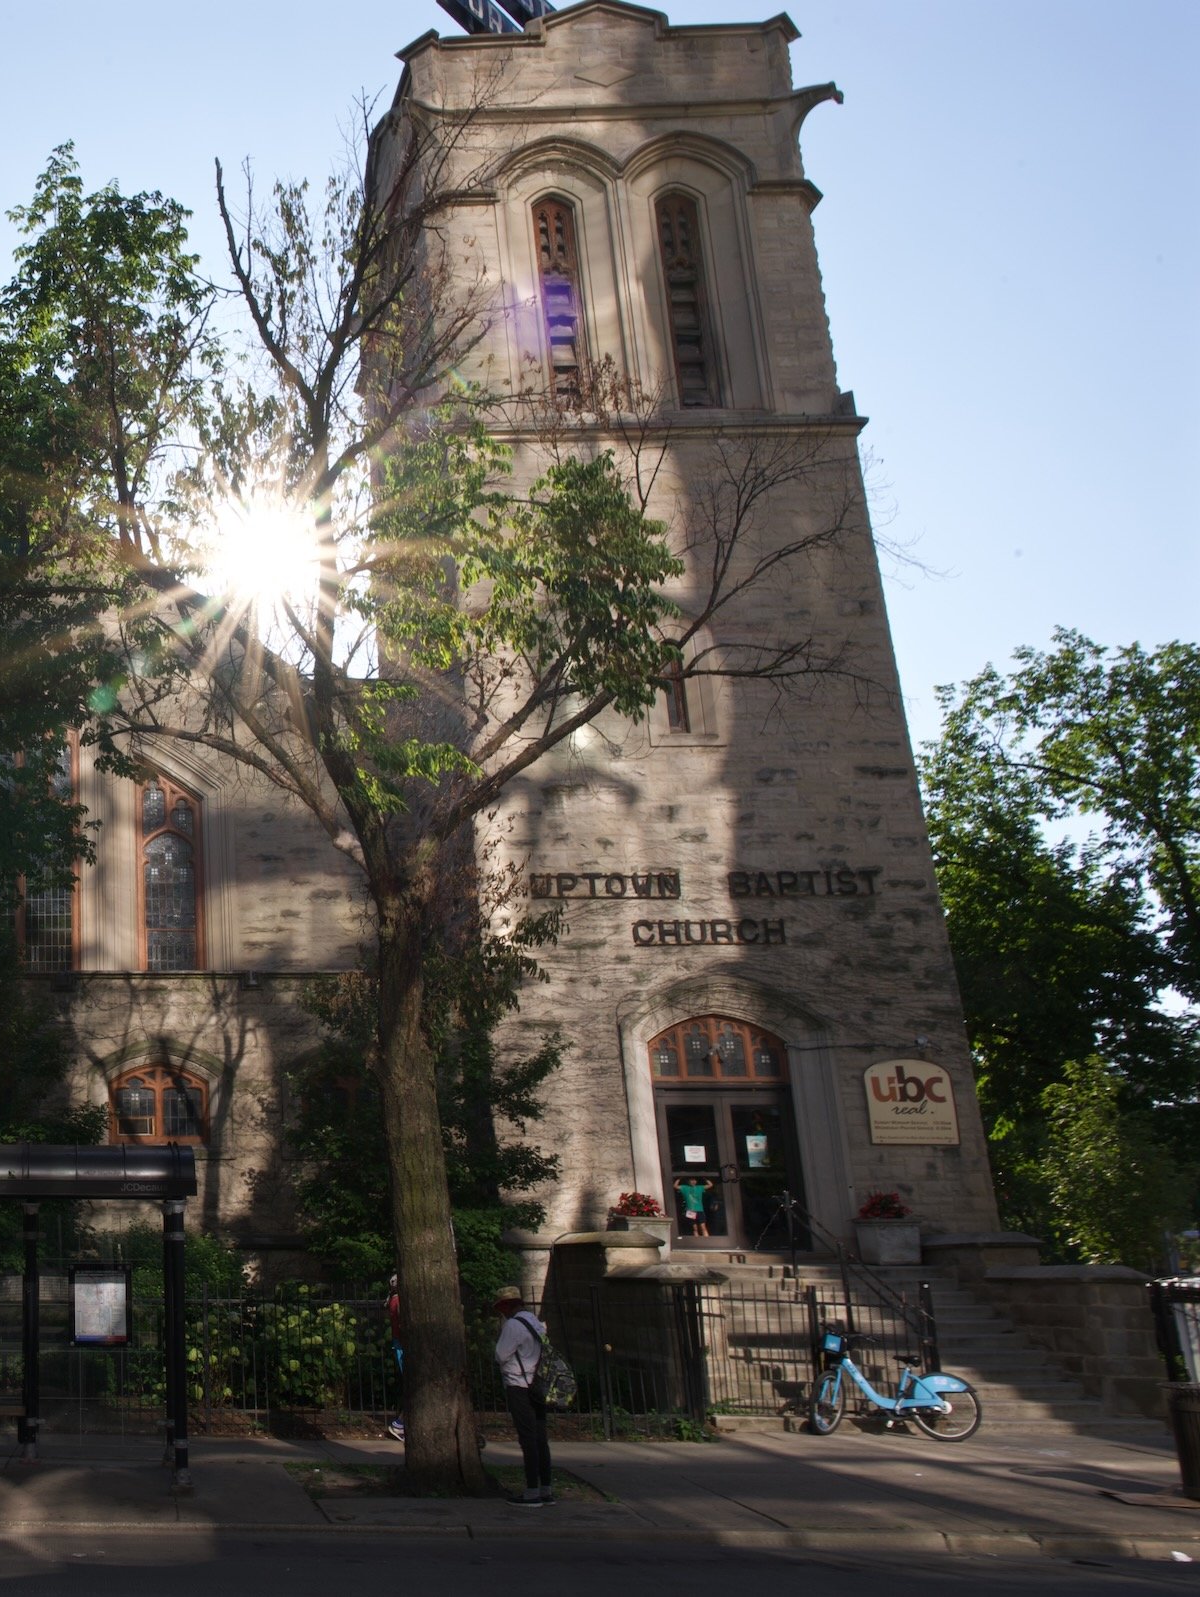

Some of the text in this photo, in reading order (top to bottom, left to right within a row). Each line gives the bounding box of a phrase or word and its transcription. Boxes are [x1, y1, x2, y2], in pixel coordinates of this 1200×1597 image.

[530, 871, 877, 899] UPTOWN BAPTIST
[633, 919, 785, 946] CHURCH
[871, 1066, 946, 1102] ubc
